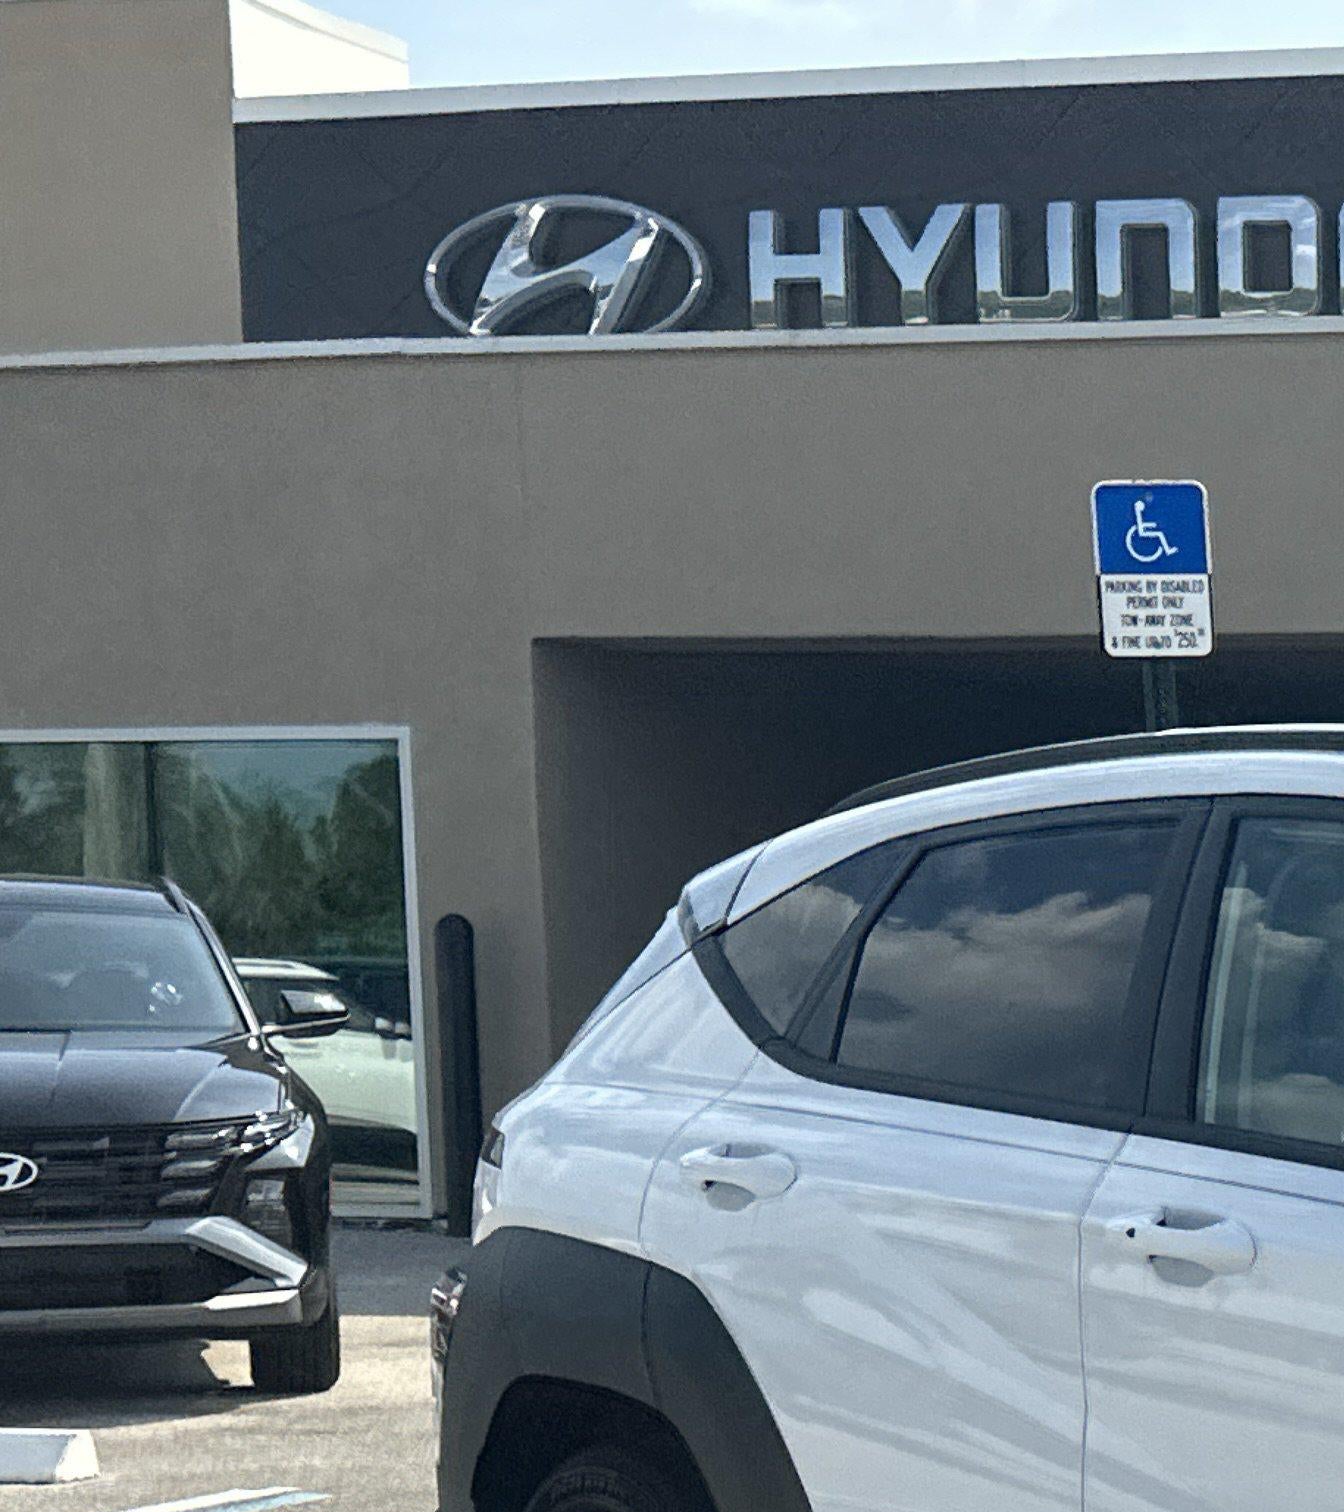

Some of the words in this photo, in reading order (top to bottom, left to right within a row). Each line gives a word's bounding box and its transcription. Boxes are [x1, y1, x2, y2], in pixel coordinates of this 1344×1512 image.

[1104, 580, 1143, 593] PARKING
[1146, 580, 1158, 593] BY
[1160, 579, 1205, 594] DISABLED
[1162, 596, 1185, 609] ONLY
[1169, 613, 1194, 627] ZONE
